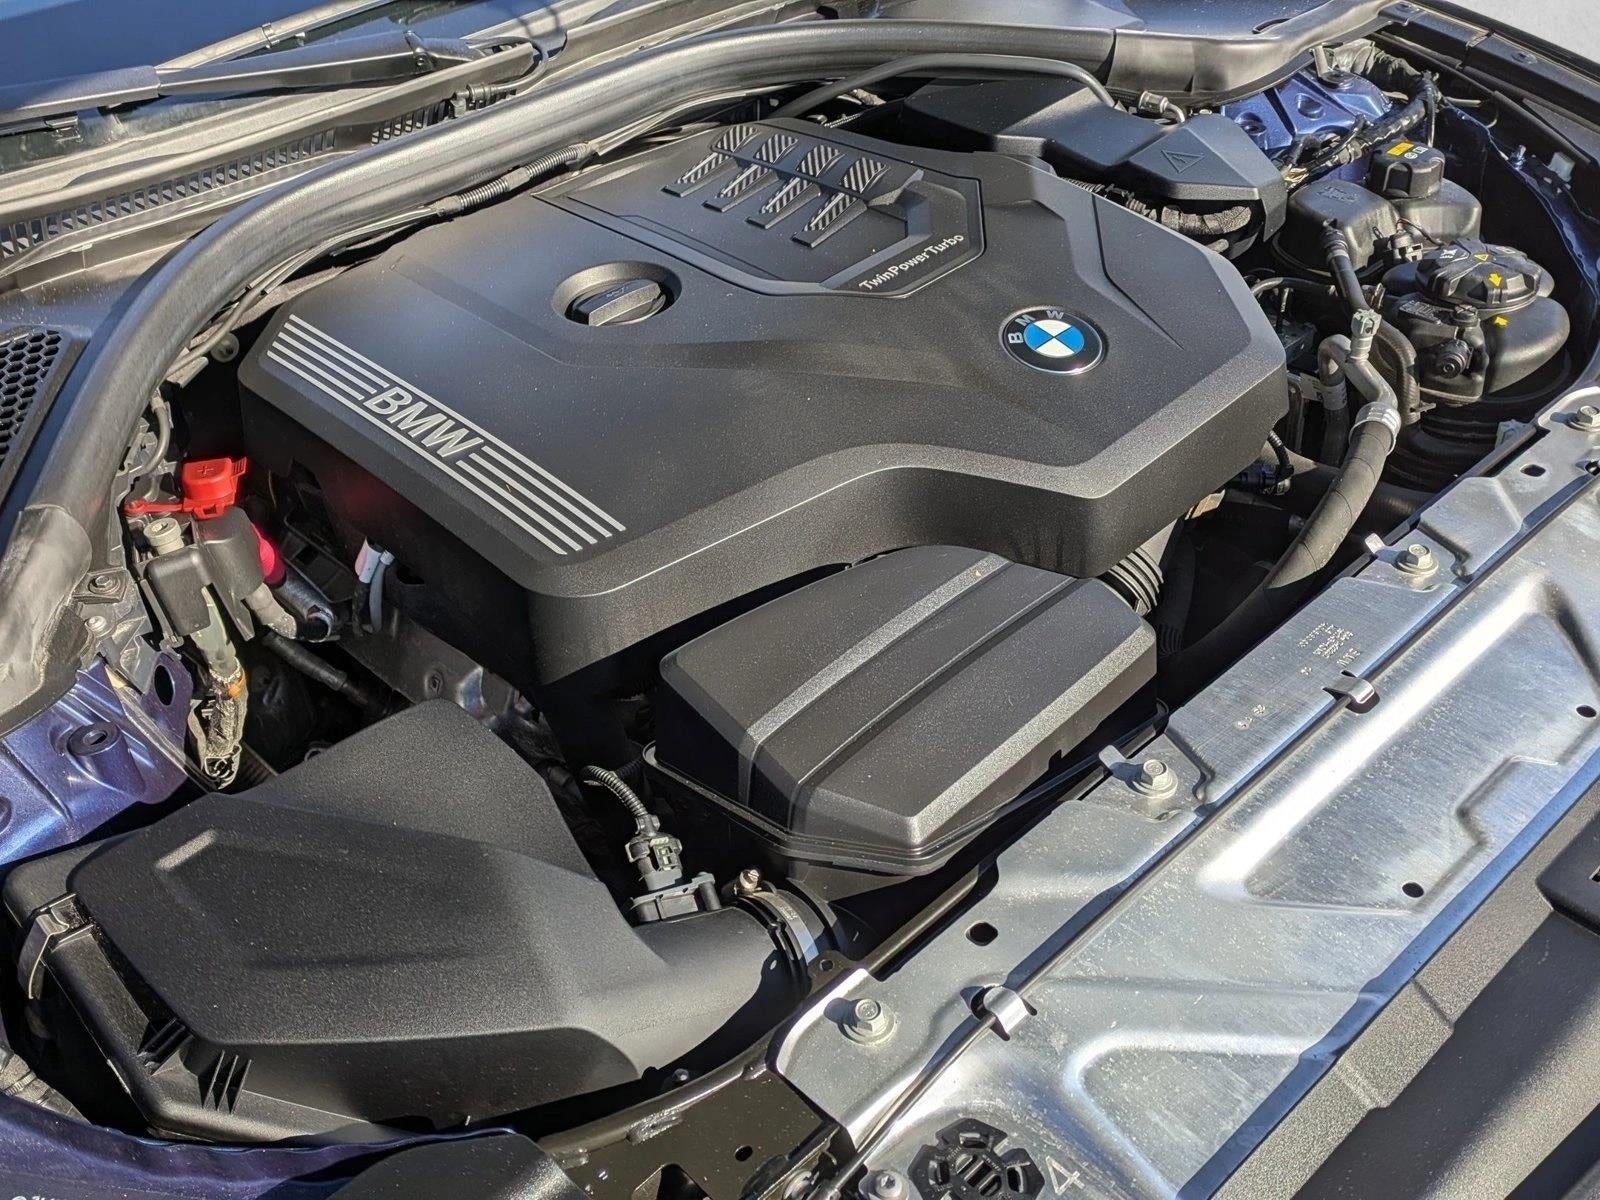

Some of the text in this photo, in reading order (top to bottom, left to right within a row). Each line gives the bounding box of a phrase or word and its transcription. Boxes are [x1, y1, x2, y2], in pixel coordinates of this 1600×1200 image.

[858, 234, 964, 290] TwinPowerTurbo
[1007, 310, 1064, 344] BMW
[362, 386, 484, 458] BMW
[1045, 1156, 1086, 1195] 4
